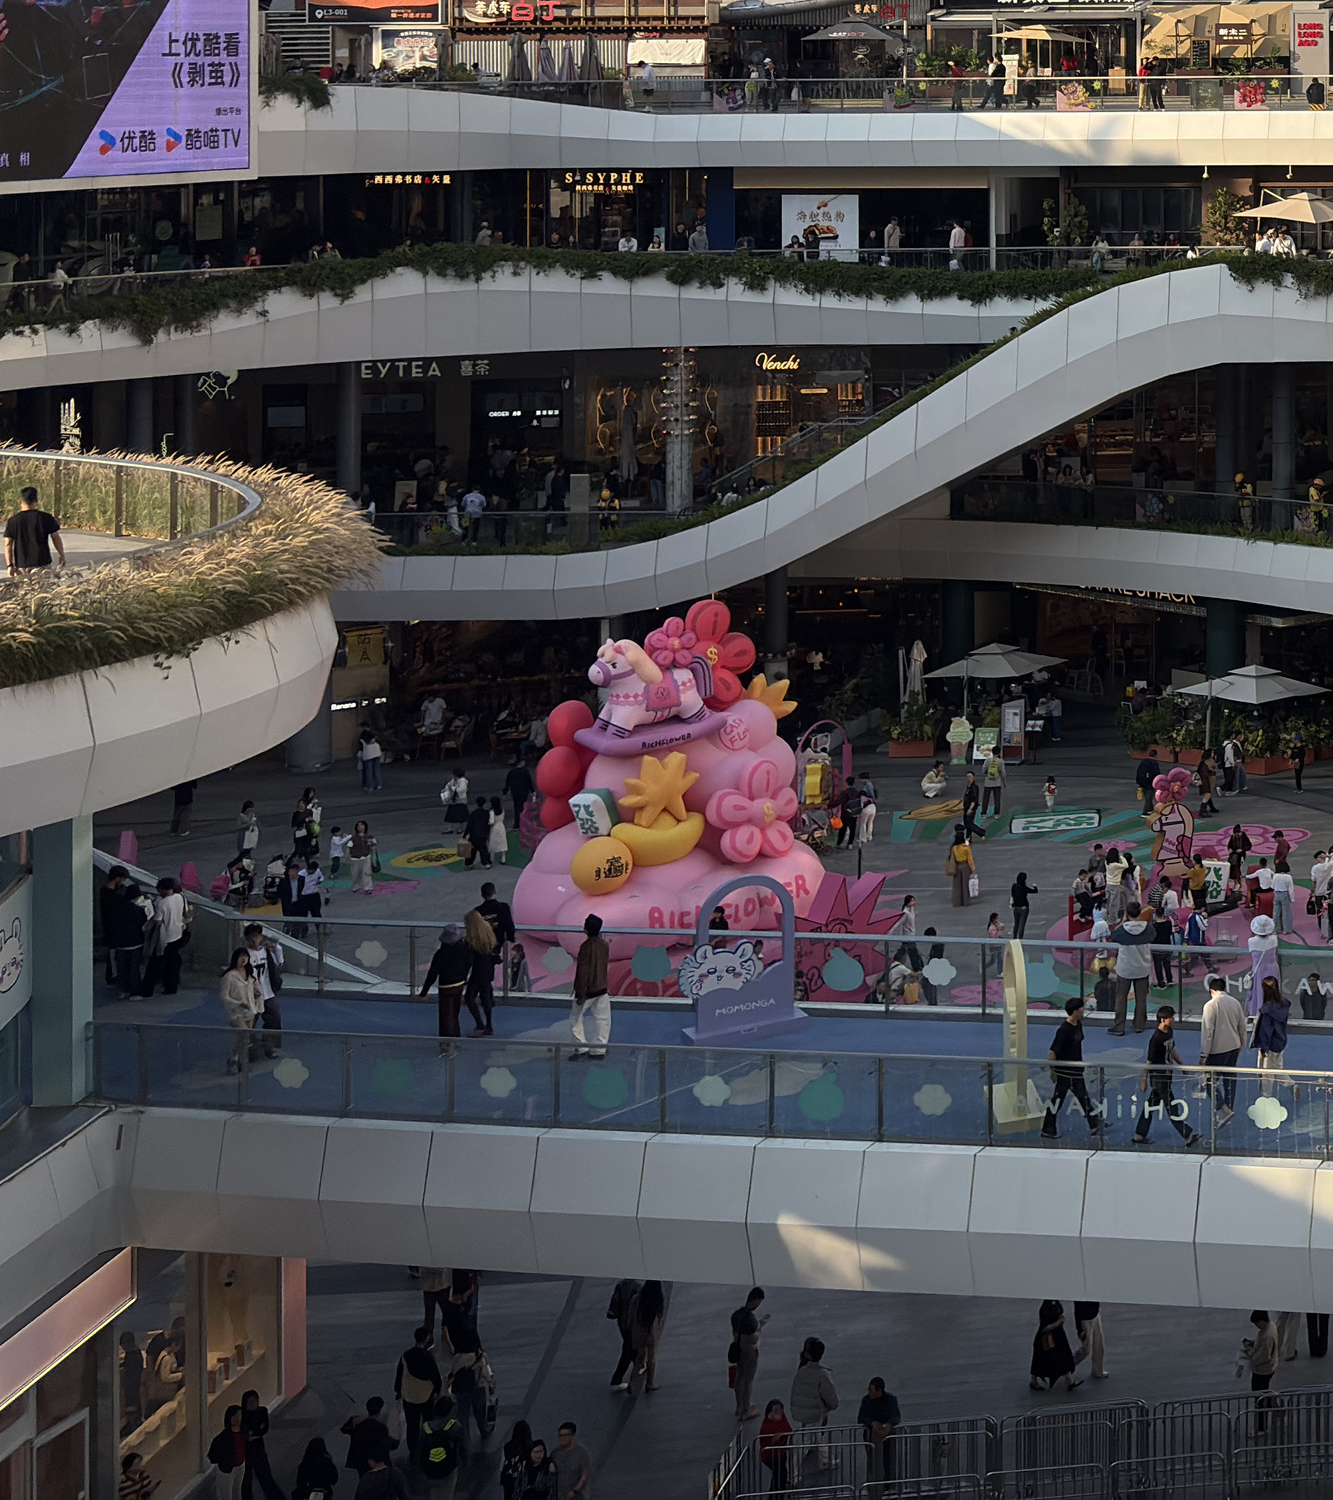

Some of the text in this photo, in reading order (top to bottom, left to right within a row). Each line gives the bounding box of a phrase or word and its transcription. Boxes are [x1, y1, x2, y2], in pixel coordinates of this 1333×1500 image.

[1297, 22, 1323, 31] LONG
[1297, 31, 1323, 39] LONG
[161, 31, 241, 58] 上优酷看
[1297, 39, 1318, 47] AGO
[120, 130, 156, 153] 优酷
[185, 127, 242, 151] 酷喵TV
[565, 172, 644, 184] SSYPHE
[458, 360, 489, 376] 喜茶
[754, 352, 800, 371] Venchi
[713, 998, 776, 1017] MOMONGA
